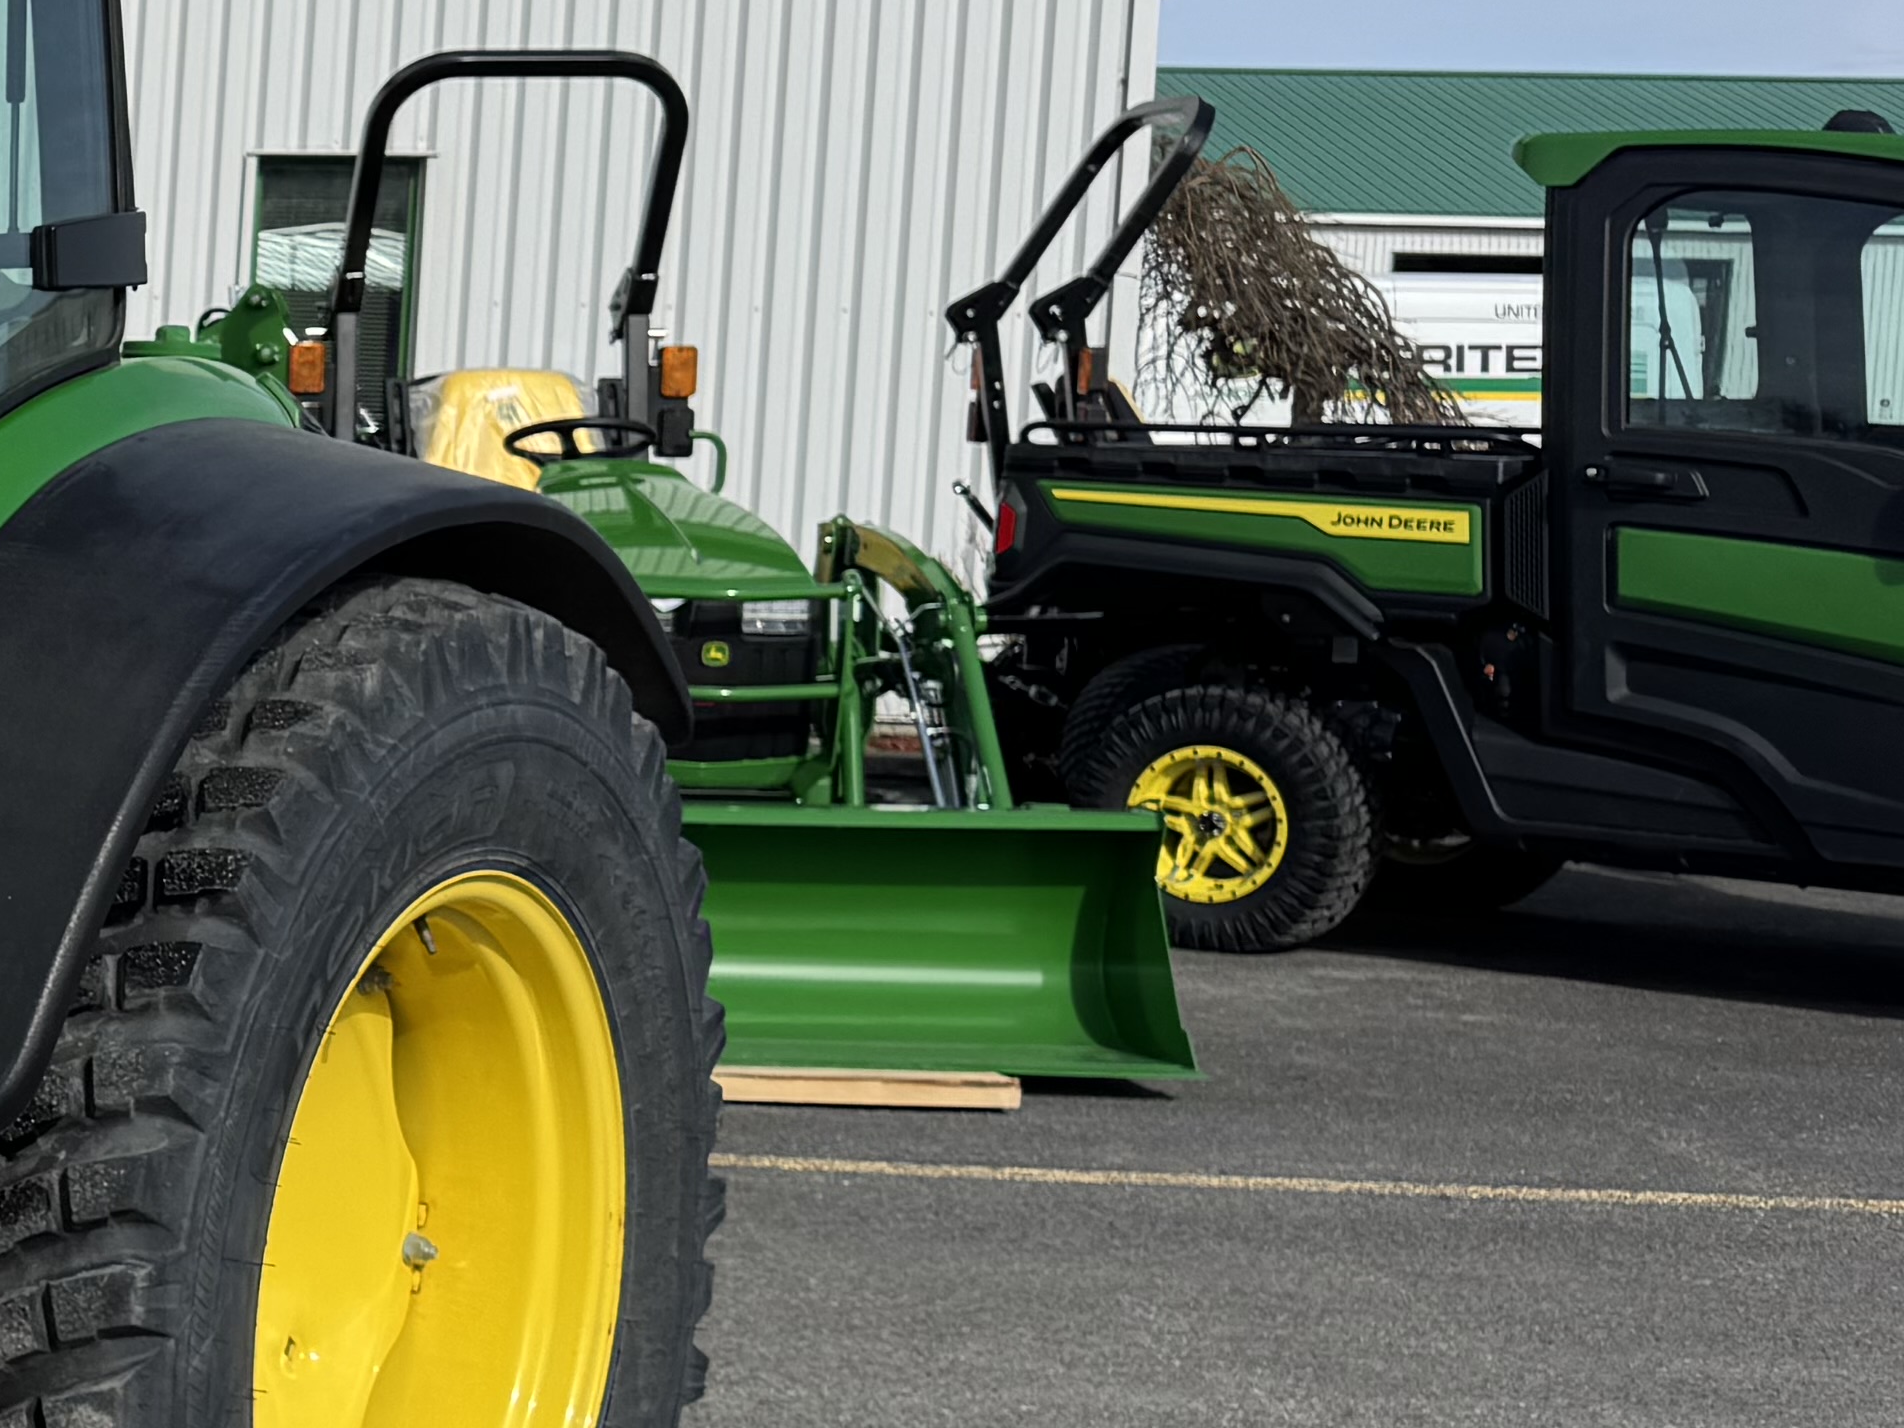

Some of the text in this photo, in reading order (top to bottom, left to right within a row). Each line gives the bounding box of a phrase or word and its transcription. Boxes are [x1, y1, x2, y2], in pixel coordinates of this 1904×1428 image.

[1415, 344, 1542, 373] RITE
[1330, 511, 1456, 533] JOHN DEERE
